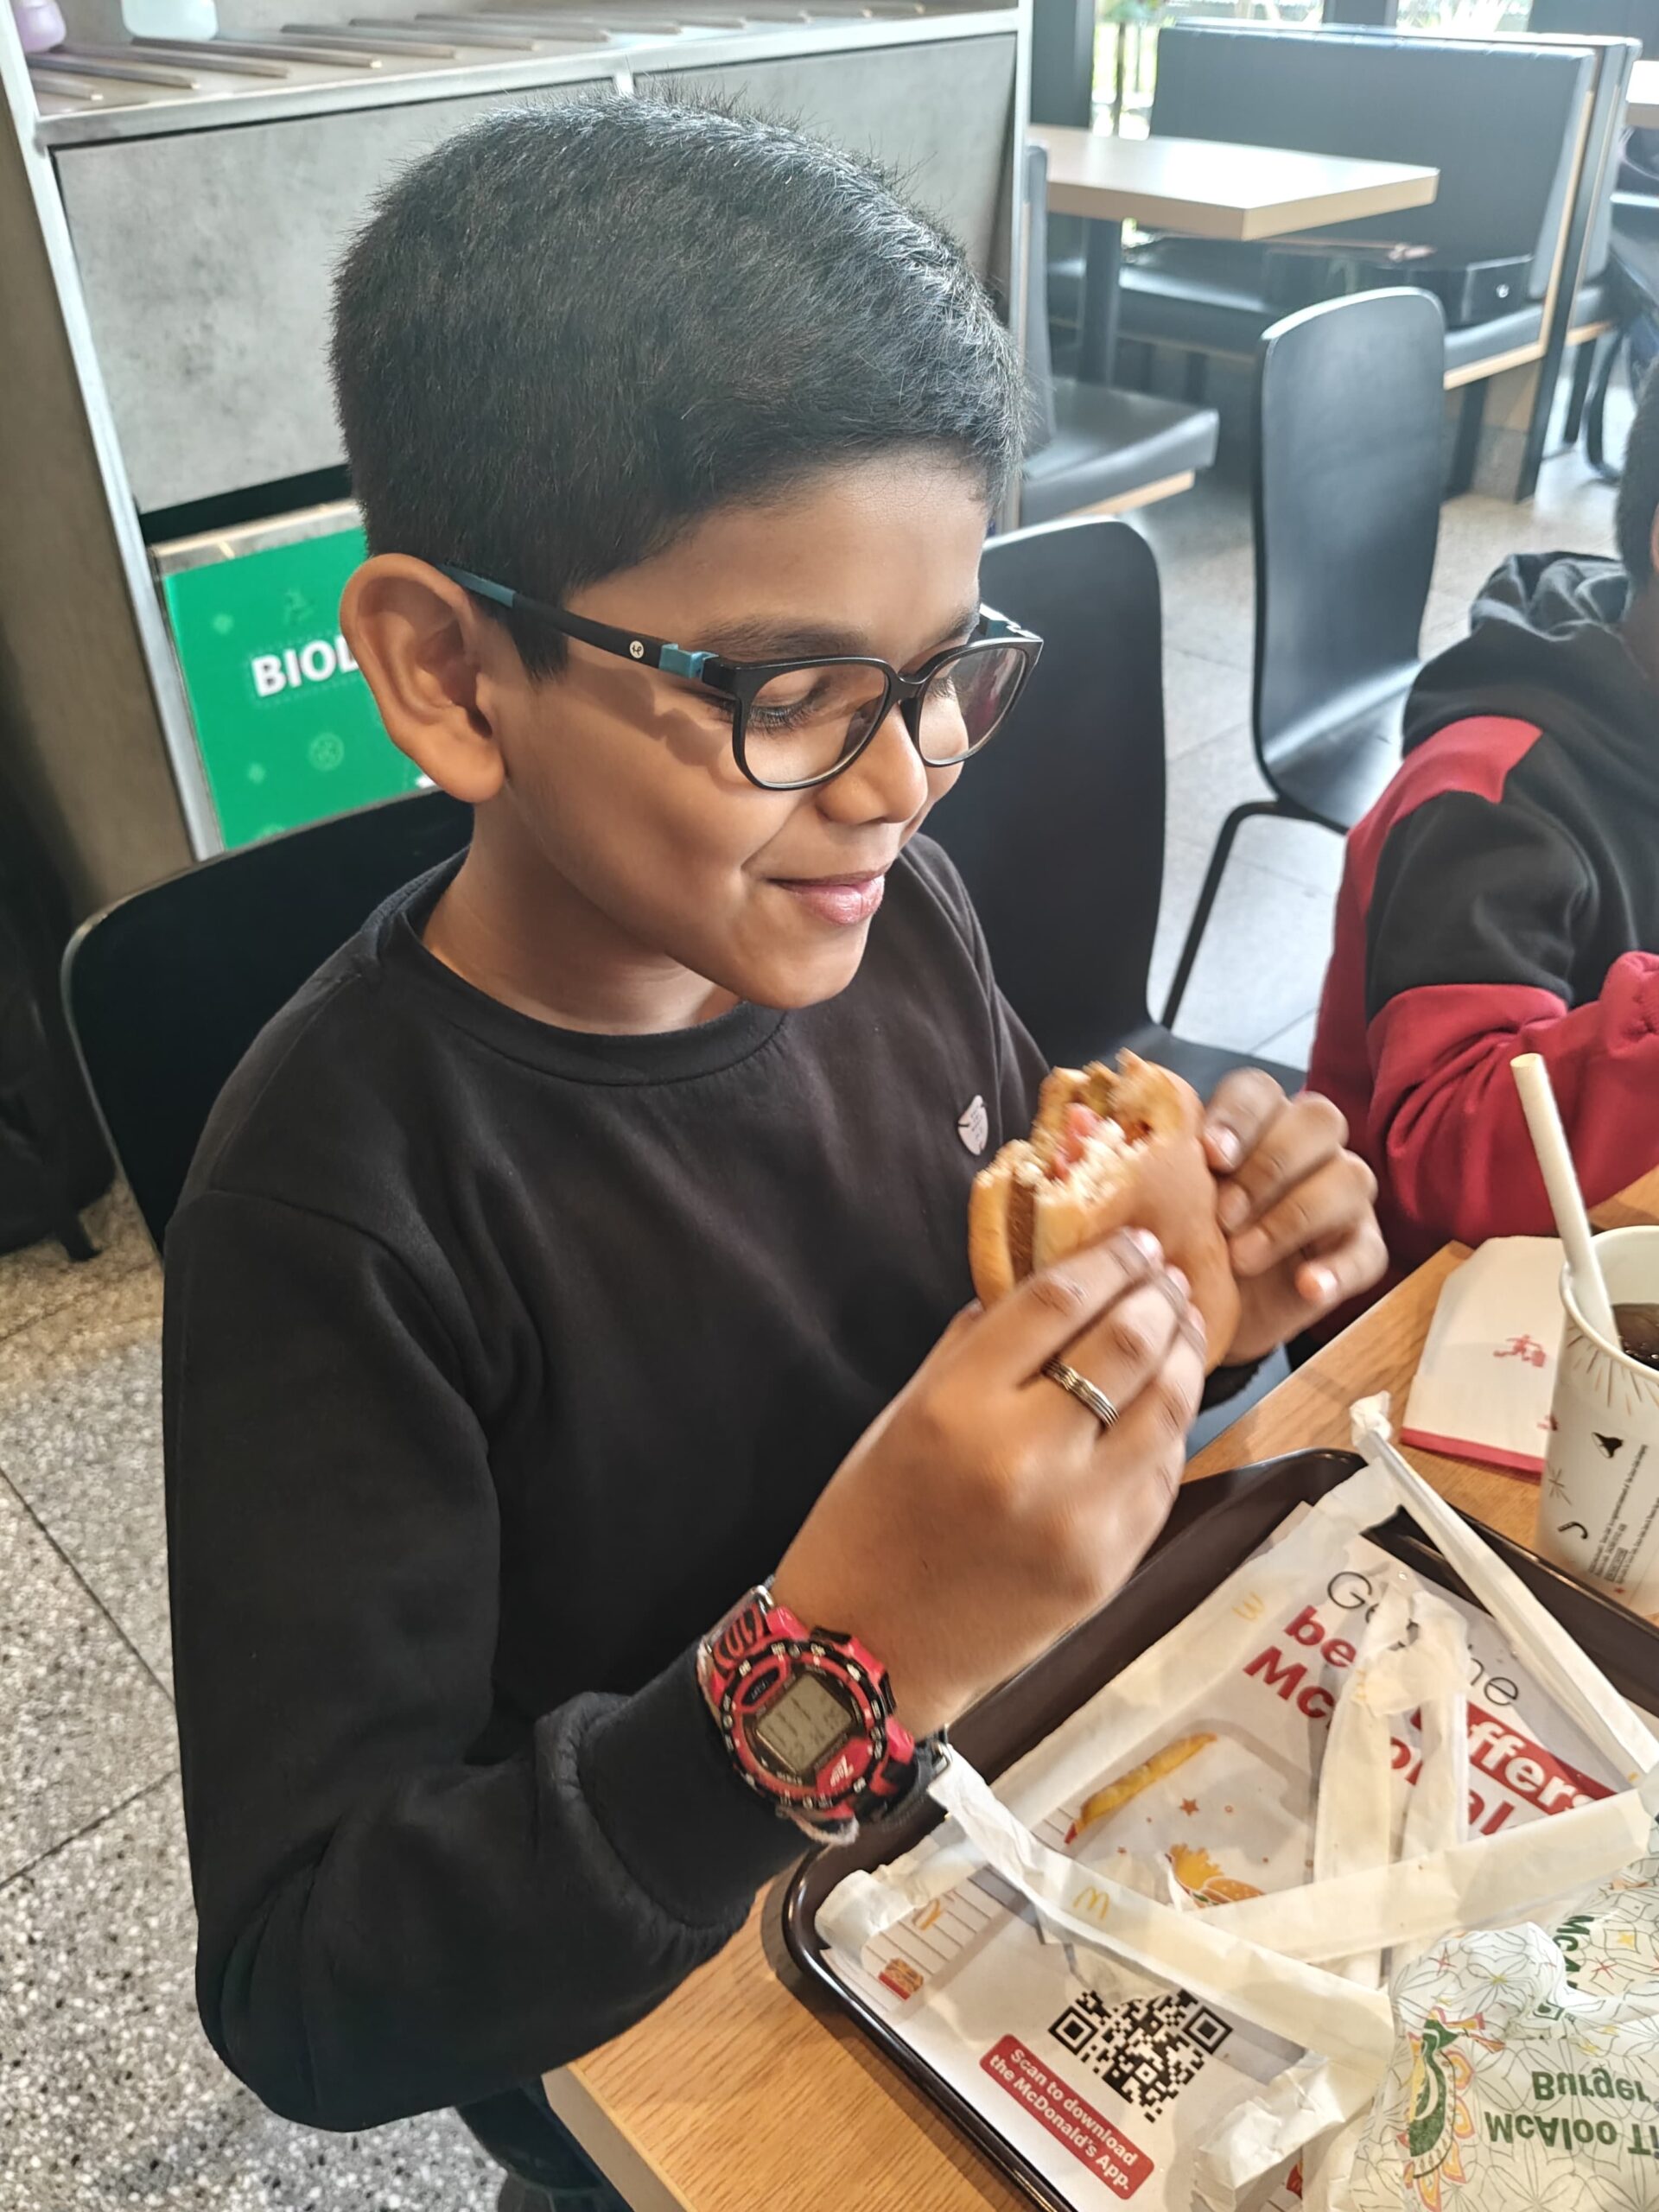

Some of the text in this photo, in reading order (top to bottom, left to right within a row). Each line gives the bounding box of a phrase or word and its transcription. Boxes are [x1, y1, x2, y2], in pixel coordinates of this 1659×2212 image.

[1283, 1605, 1357, 1669] be
[1469, 1721, 1597, 1809] ffer
[989, 2054, 1130, 2191] the McDonald's App.
[1011, 2049, 1139, 2166] Scan to download
